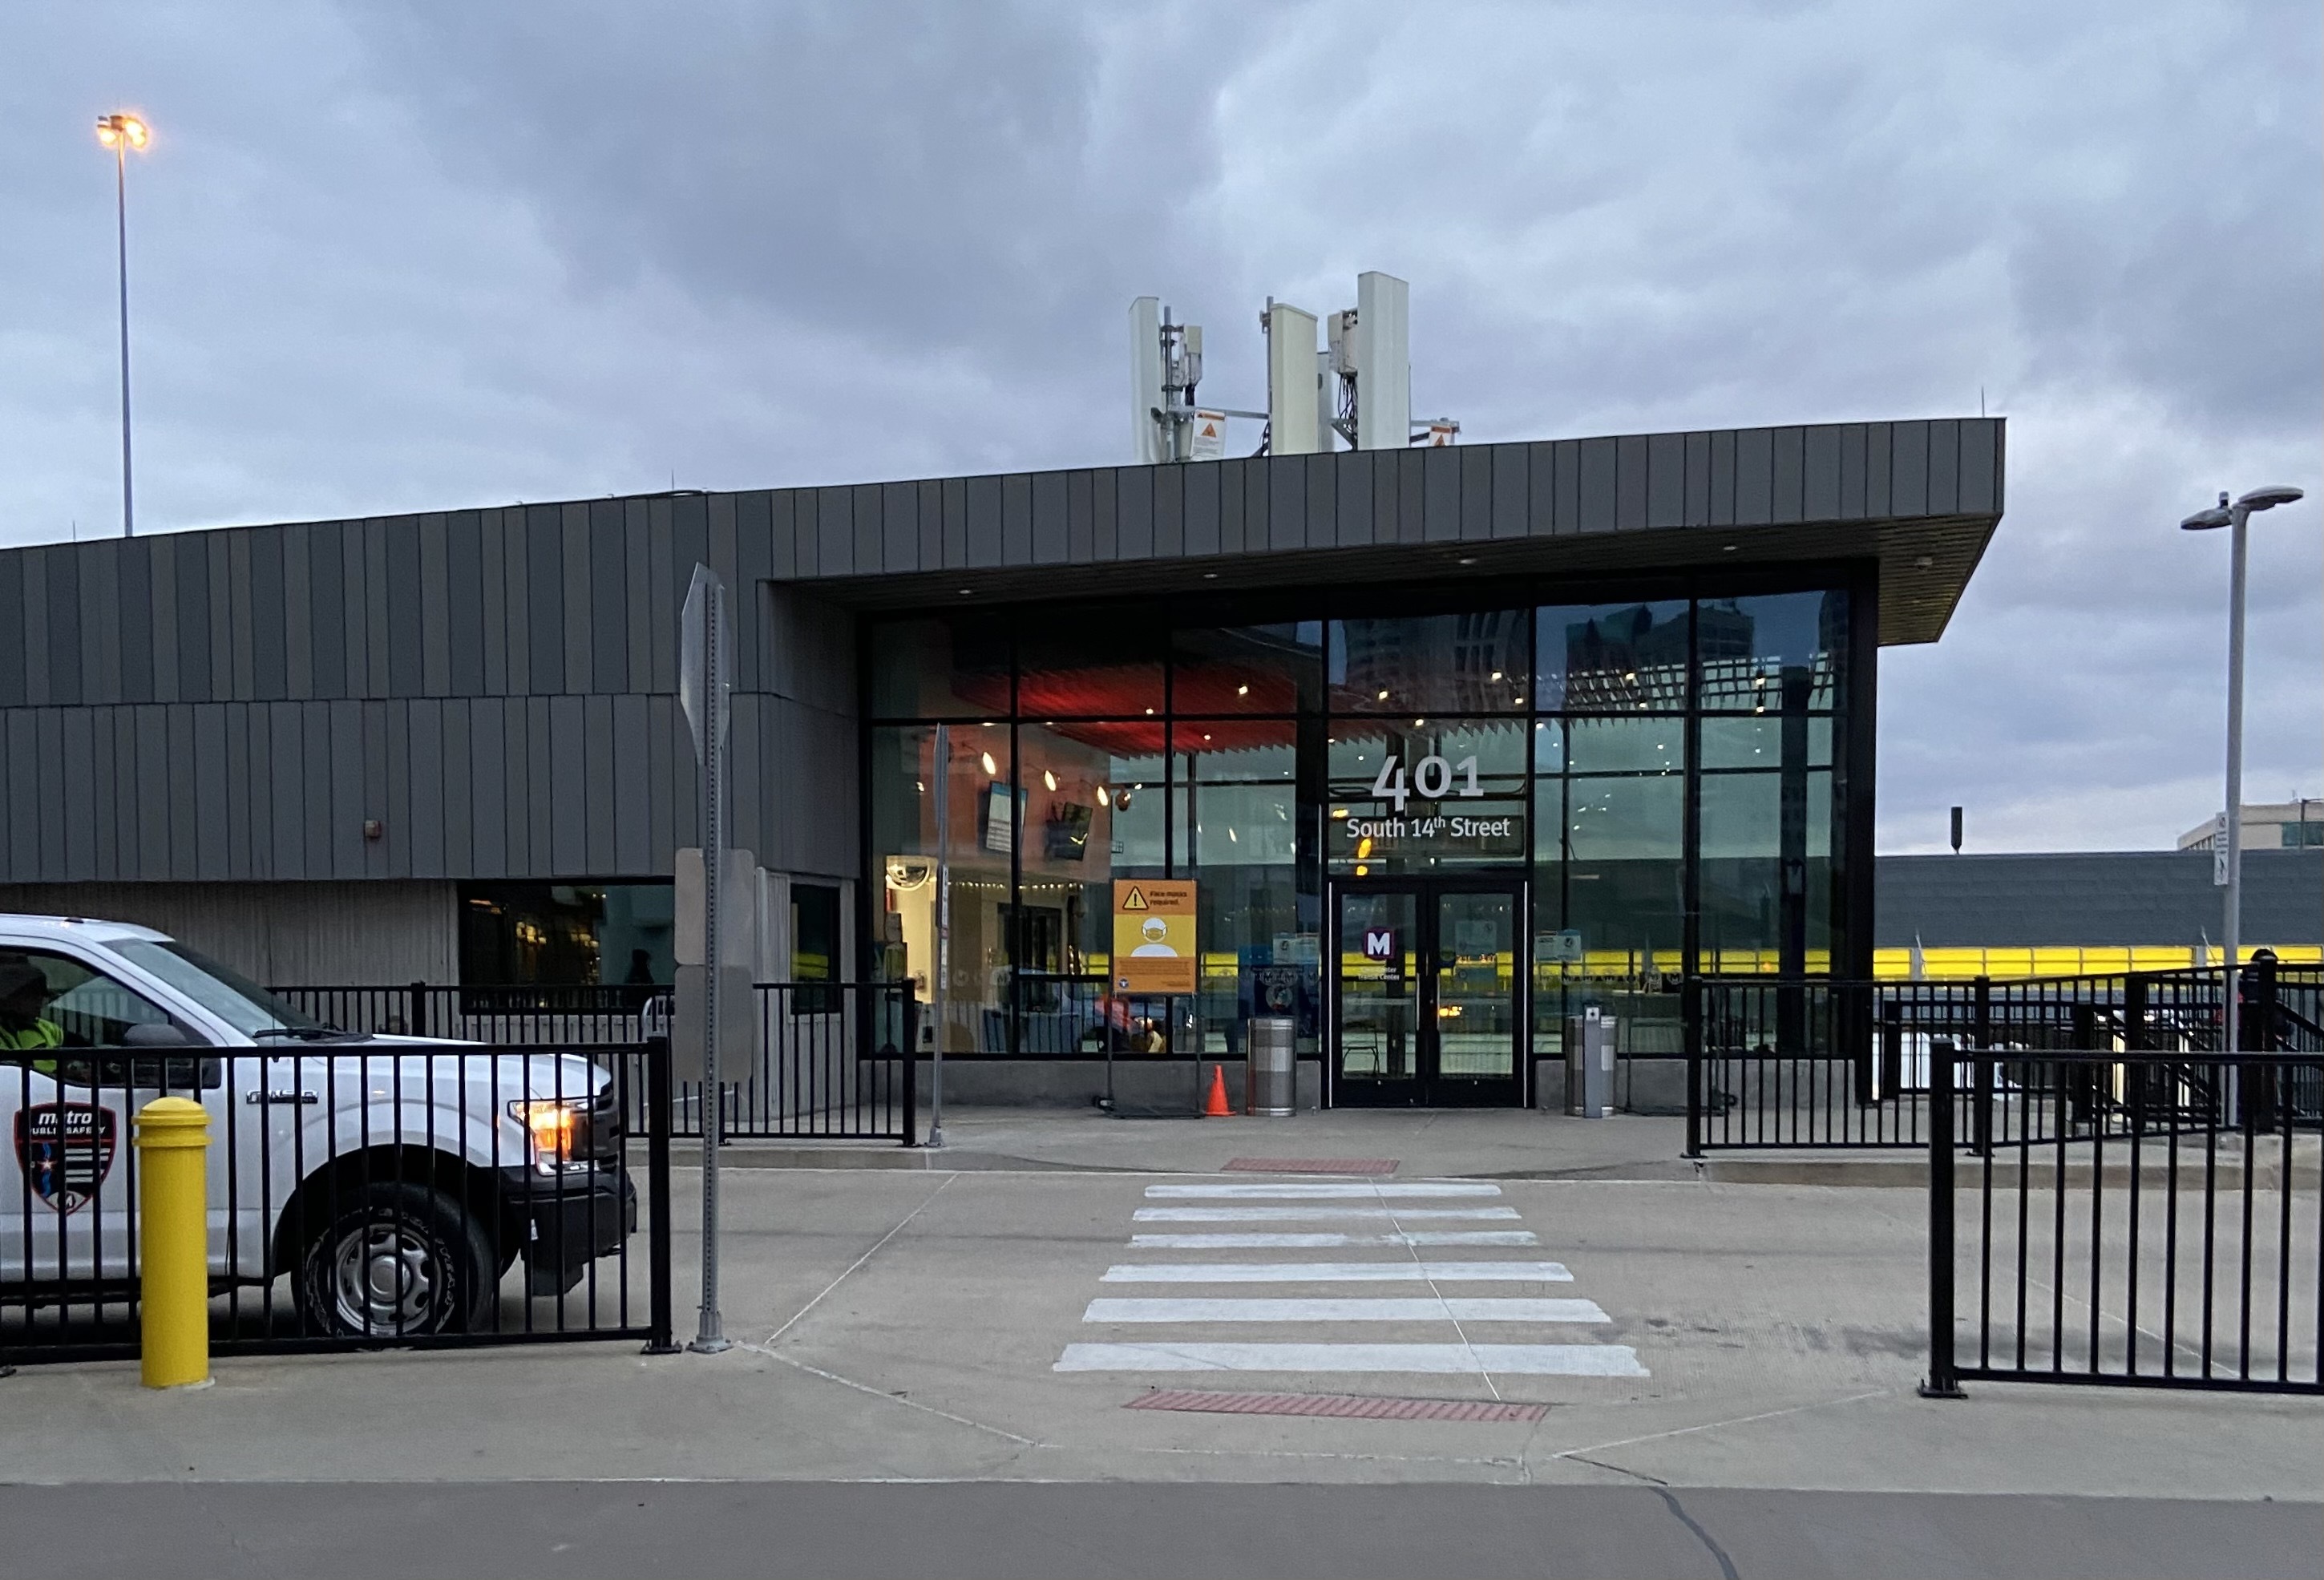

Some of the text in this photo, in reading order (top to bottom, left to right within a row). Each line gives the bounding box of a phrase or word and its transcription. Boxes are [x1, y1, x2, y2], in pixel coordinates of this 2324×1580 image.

[1372, 755, 1484, 812] 401
[1346, 815, 1511, 838] South 14th Street
[1367, 932, 1390, 956] M
[38, 1110, 92, 1125] mtro
[66, 1126, 106, 1135] SAFEY
